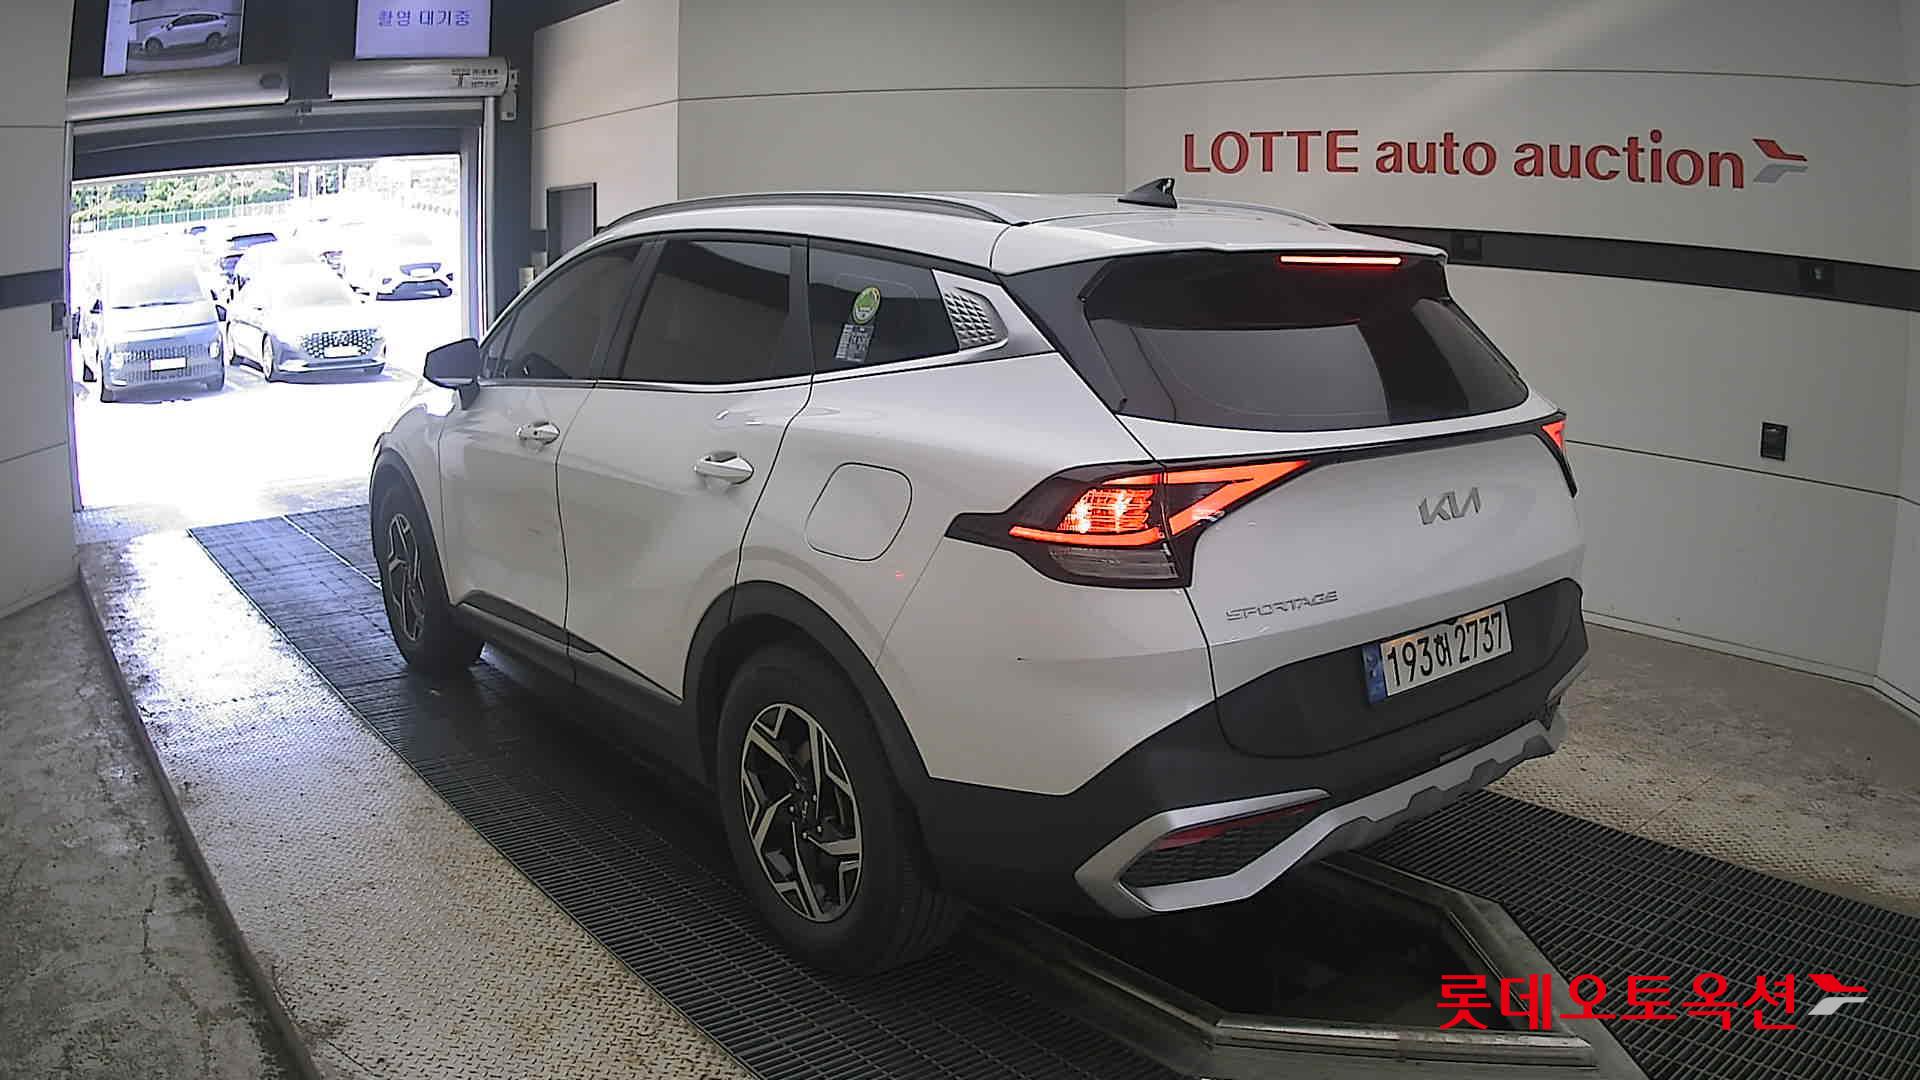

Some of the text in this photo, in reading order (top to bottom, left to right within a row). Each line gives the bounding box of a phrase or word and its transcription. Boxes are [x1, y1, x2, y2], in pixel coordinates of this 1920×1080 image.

[419, 9, 471, 27] 대기중
[1184, 129, 1745, 189] LOTTE auto auction
[1417, 487, 1482, 526] KIA
[1225, 590, 1339, 622] SPORTAGE
